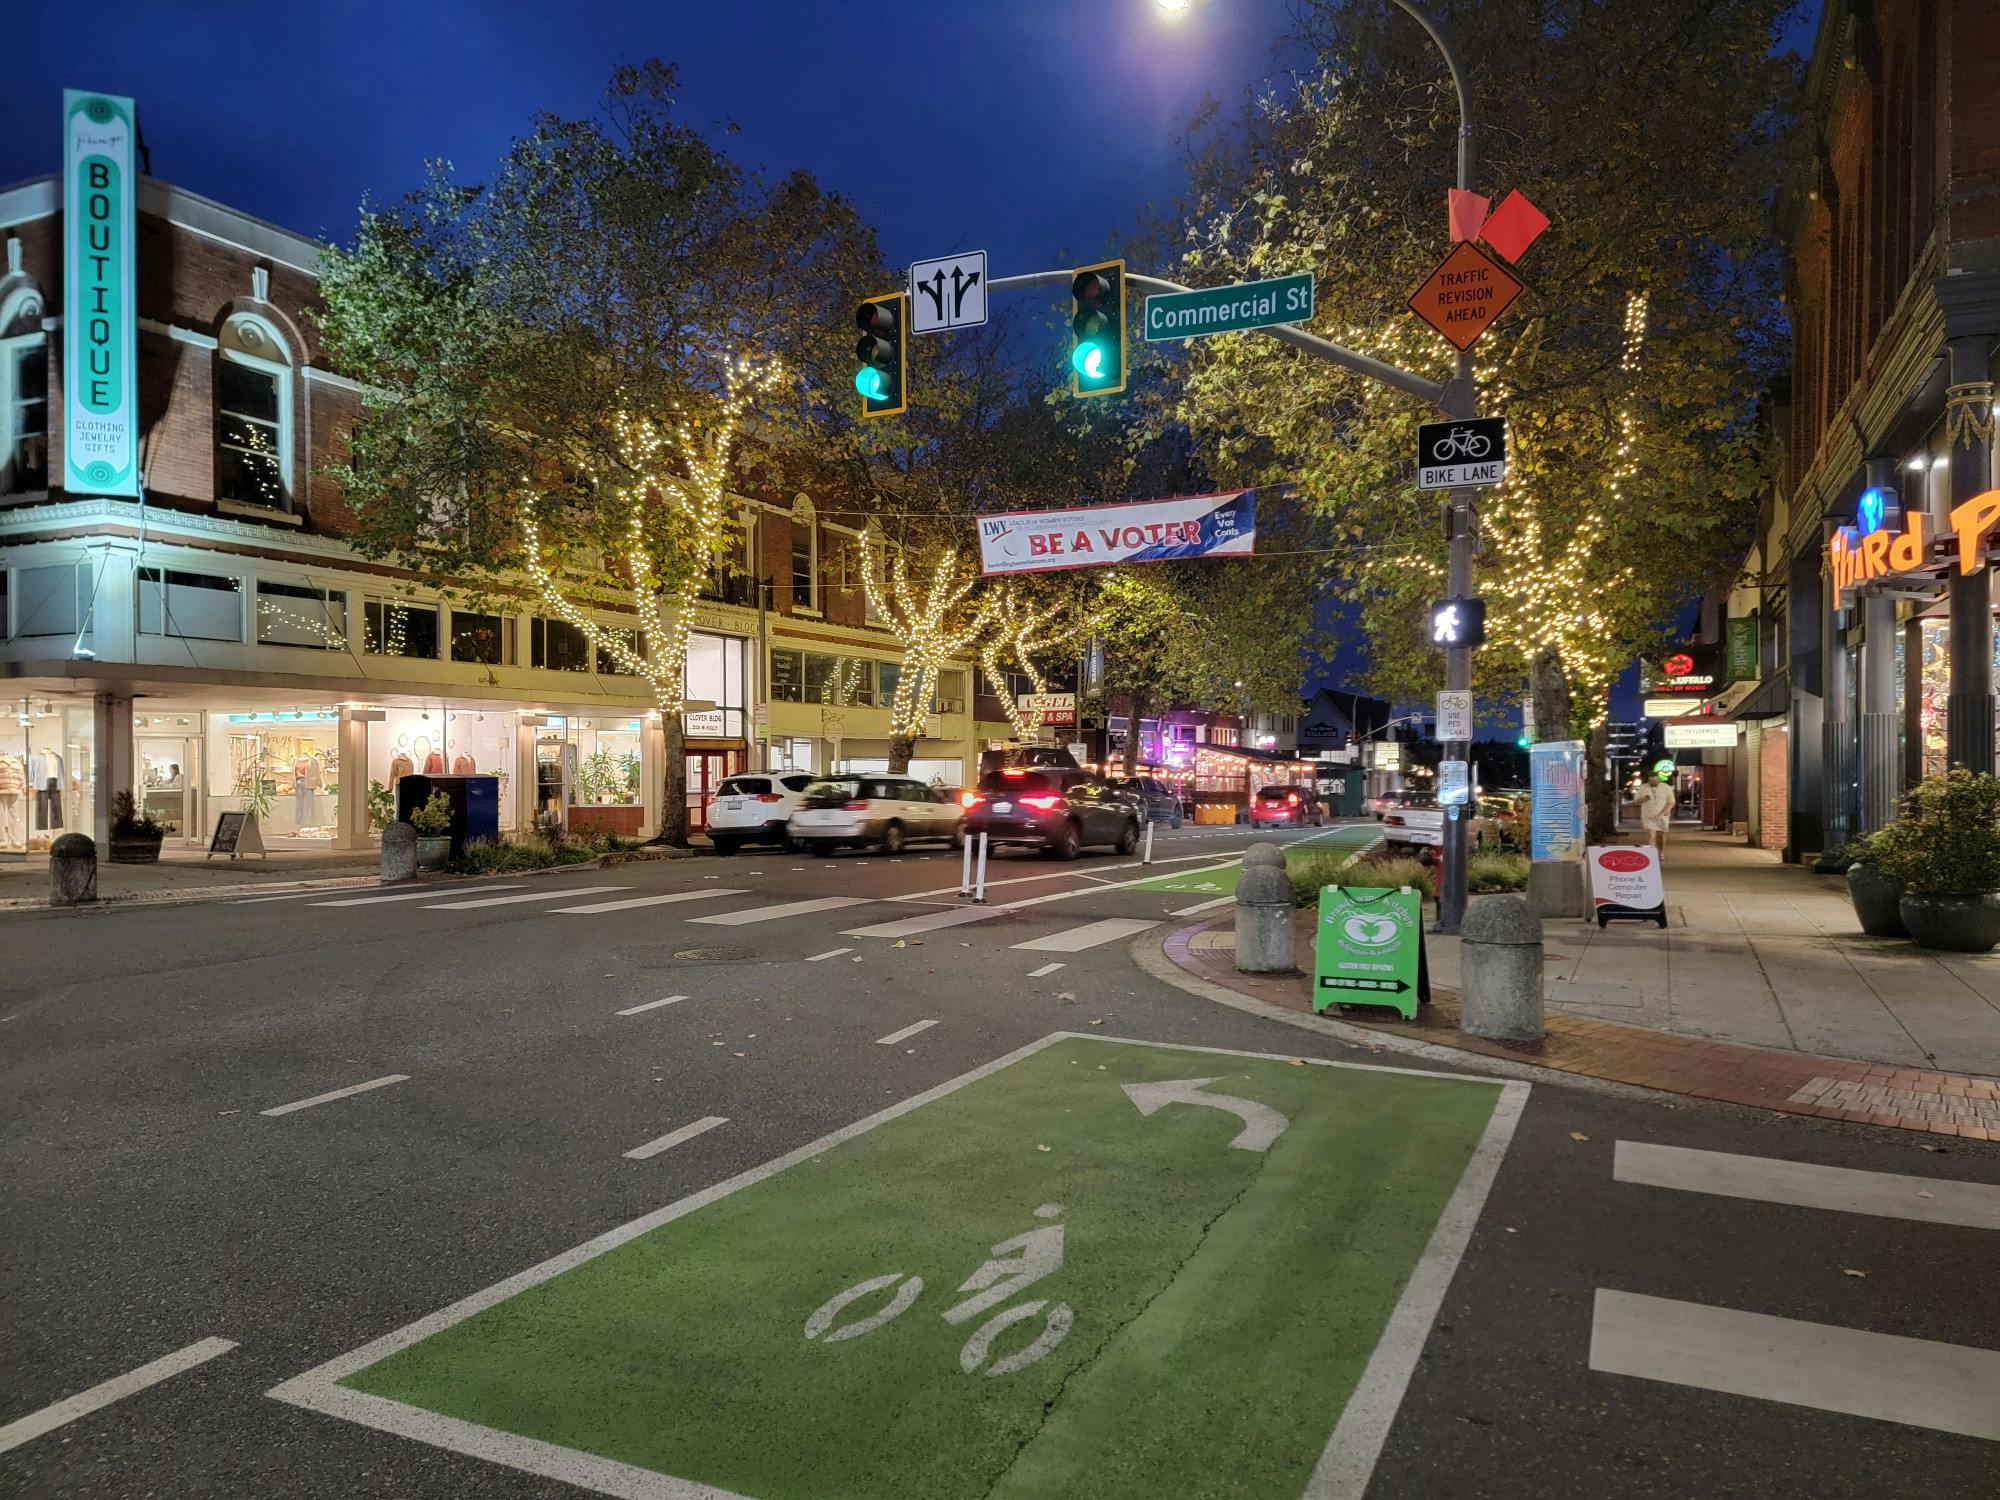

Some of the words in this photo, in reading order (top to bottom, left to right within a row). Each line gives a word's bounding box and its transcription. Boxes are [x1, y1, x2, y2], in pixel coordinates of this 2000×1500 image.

[1439, 268, 1490, 287] TRAFFIC
[88, 161, 111, 407] BOUTIQUE
[1438, 286, 1494, 306] REVISION
[1150, 291, 1277, 330] Commercial
[1286, 285, 1308, 311] St
[1445, 306, 1487, 323] AHEAD
[75, 420, 124, 433] CLOTHING
[79, 432, 121, 443] JEWELRY
[84, 443, 116, 454] GIFTS
[1425, 468, 1456, 485] BIKE
[1463, 464, 1498, 482] LANE
[1214, 510, 1237, 520] Every
[983, 520, 1007, 536] LWV
[1216, 520, 1235, 528] Voe
[1214, 528, 1240, 538] Conts
[1028, 532, 1065, 557] BE
[1070, 530, 1095, 553] A
[1097, 520, 1202, 550] VOTER
[688, 714, 708, 722] CLOVER
[1020, 712, 1046, 722] NAS
[1047, 712, 1055, 722] &
[1055, 712, 1073, 721] SPA
[1447, 712, 1461, 720] USE
[1447, 720, 1461, 728] PED
[1442, 728, 1467, 736] GNAL
[1608, 875, 1636, 883] Phone
[1638, 875, 1645, 883] &
[1607, 883, 1649, 892] Computer
[1615, 891, 1643, 900] Repair
